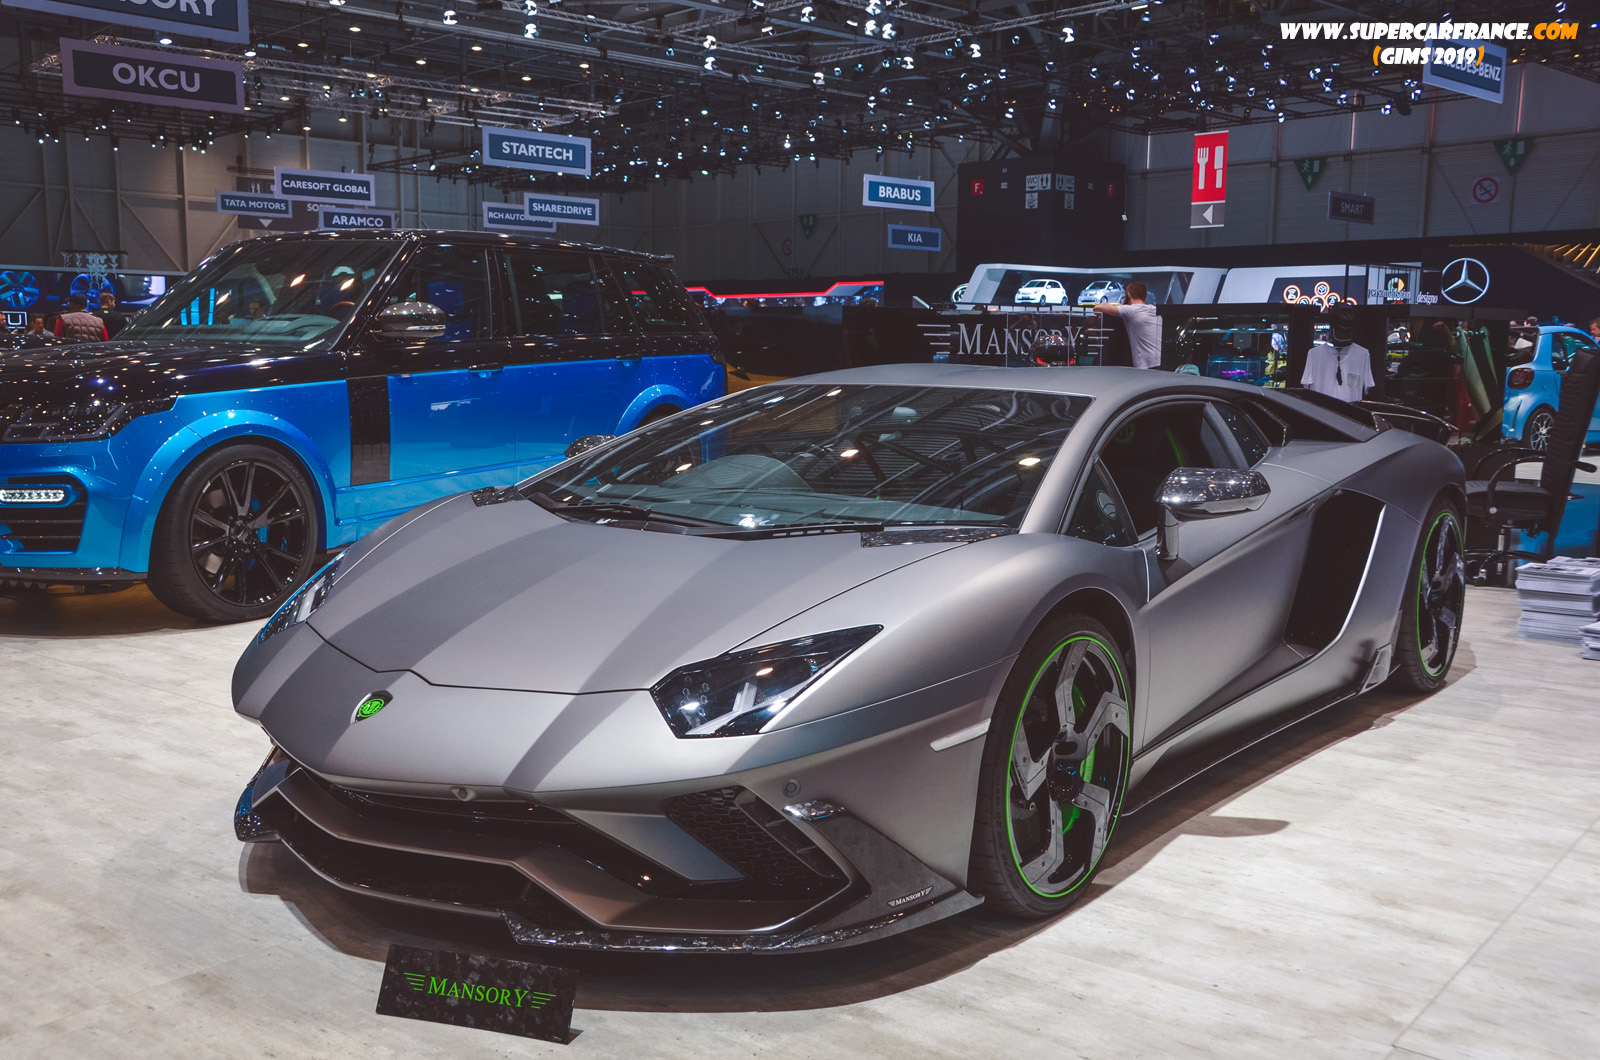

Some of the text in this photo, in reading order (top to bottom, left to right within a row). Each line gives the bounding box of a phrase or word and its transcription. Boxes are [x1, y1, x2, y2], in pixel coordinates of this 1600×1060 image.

[112, 62, 201, 93] OKCU
[502, 141, 573, 161] STARTECH
[282, 179, 369, 194] CARESOFT GLOBAL
[878, 185, 921, 201] BRABUS
[224, 198, 286, 211] TATA MOTORS
[532, 202, 592, 216] SHARE2DRIVE
[1340, 201, 1365, 216] SMART
[331, 214, 384, 228] ARAMCO
[488, 211, 504, 219] RCH
[907, 232, 923, 243] KIA
[895, 889, 926, 906] MANSORY
[427, 976, 529, 1008] MANSORY
